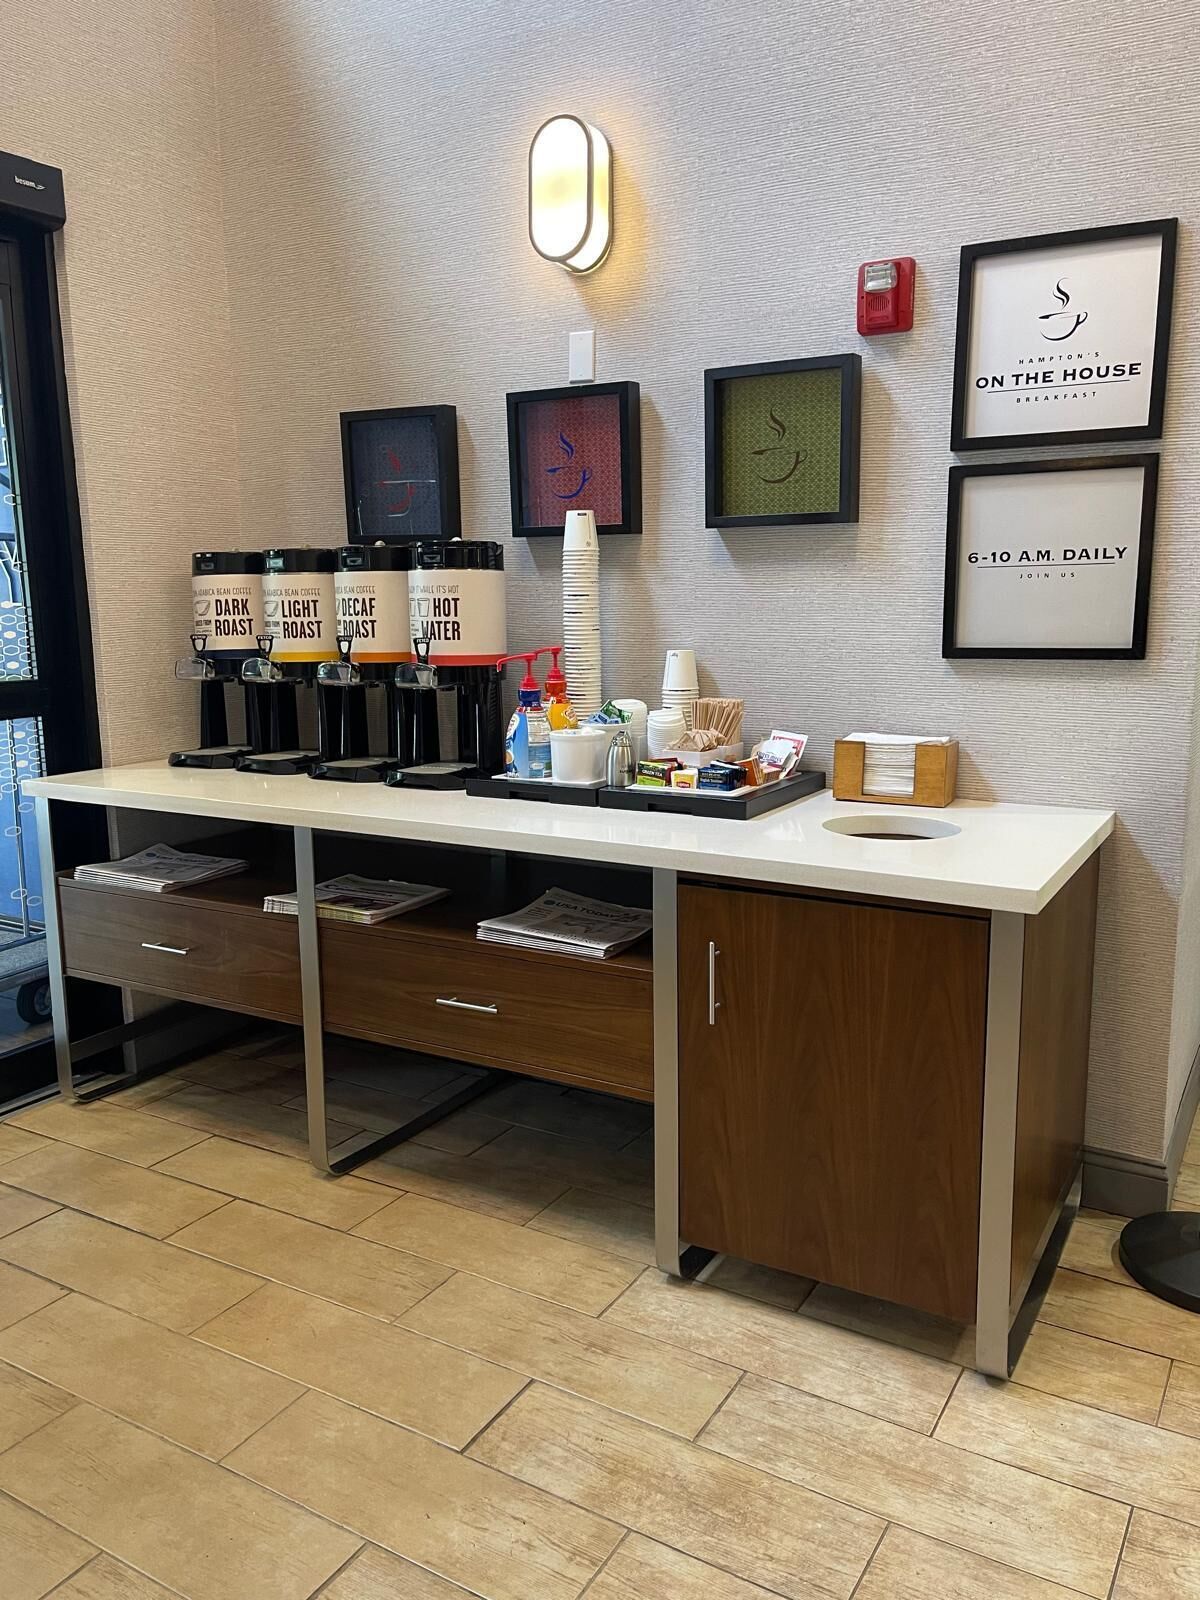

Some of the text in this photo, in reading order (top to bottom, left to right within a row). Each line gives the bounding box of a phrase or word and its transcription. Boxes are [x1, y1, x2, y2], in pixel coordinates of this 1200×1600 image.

[1018, 351, 1100, 365] HAMPTON'S
[975, 362, 1142, 389] ON THE HOUSE
[1016, 391, 1097, 404] BREAKFAST
[968, 546, 1128, 564] 6-10 A.M. DAILY
[216, 587, 231, 596] BEAN
[232, 586, 252, 595] COFFEE
[284, 588, 299, 597] BEAN
[300, 587, 320, 597] COFFEE
[355, 585, 375, 594] COFFEE
[447, 585, 459, 594] HOT
[215, 598, 250, 616] DARK
[281, 599, 319, 618] LIGHT
[341, 597, 376, 616] DECAF
[433, 597, 460, 617] HOT
[215, 618, 254, 636] ROAST
[282, 620, 322, 639] ROAST
[342, 619, 377, 638] ROAST
[421, 620, 461, 640] WATER
[555, 901, 619, 920] USA TODAY
